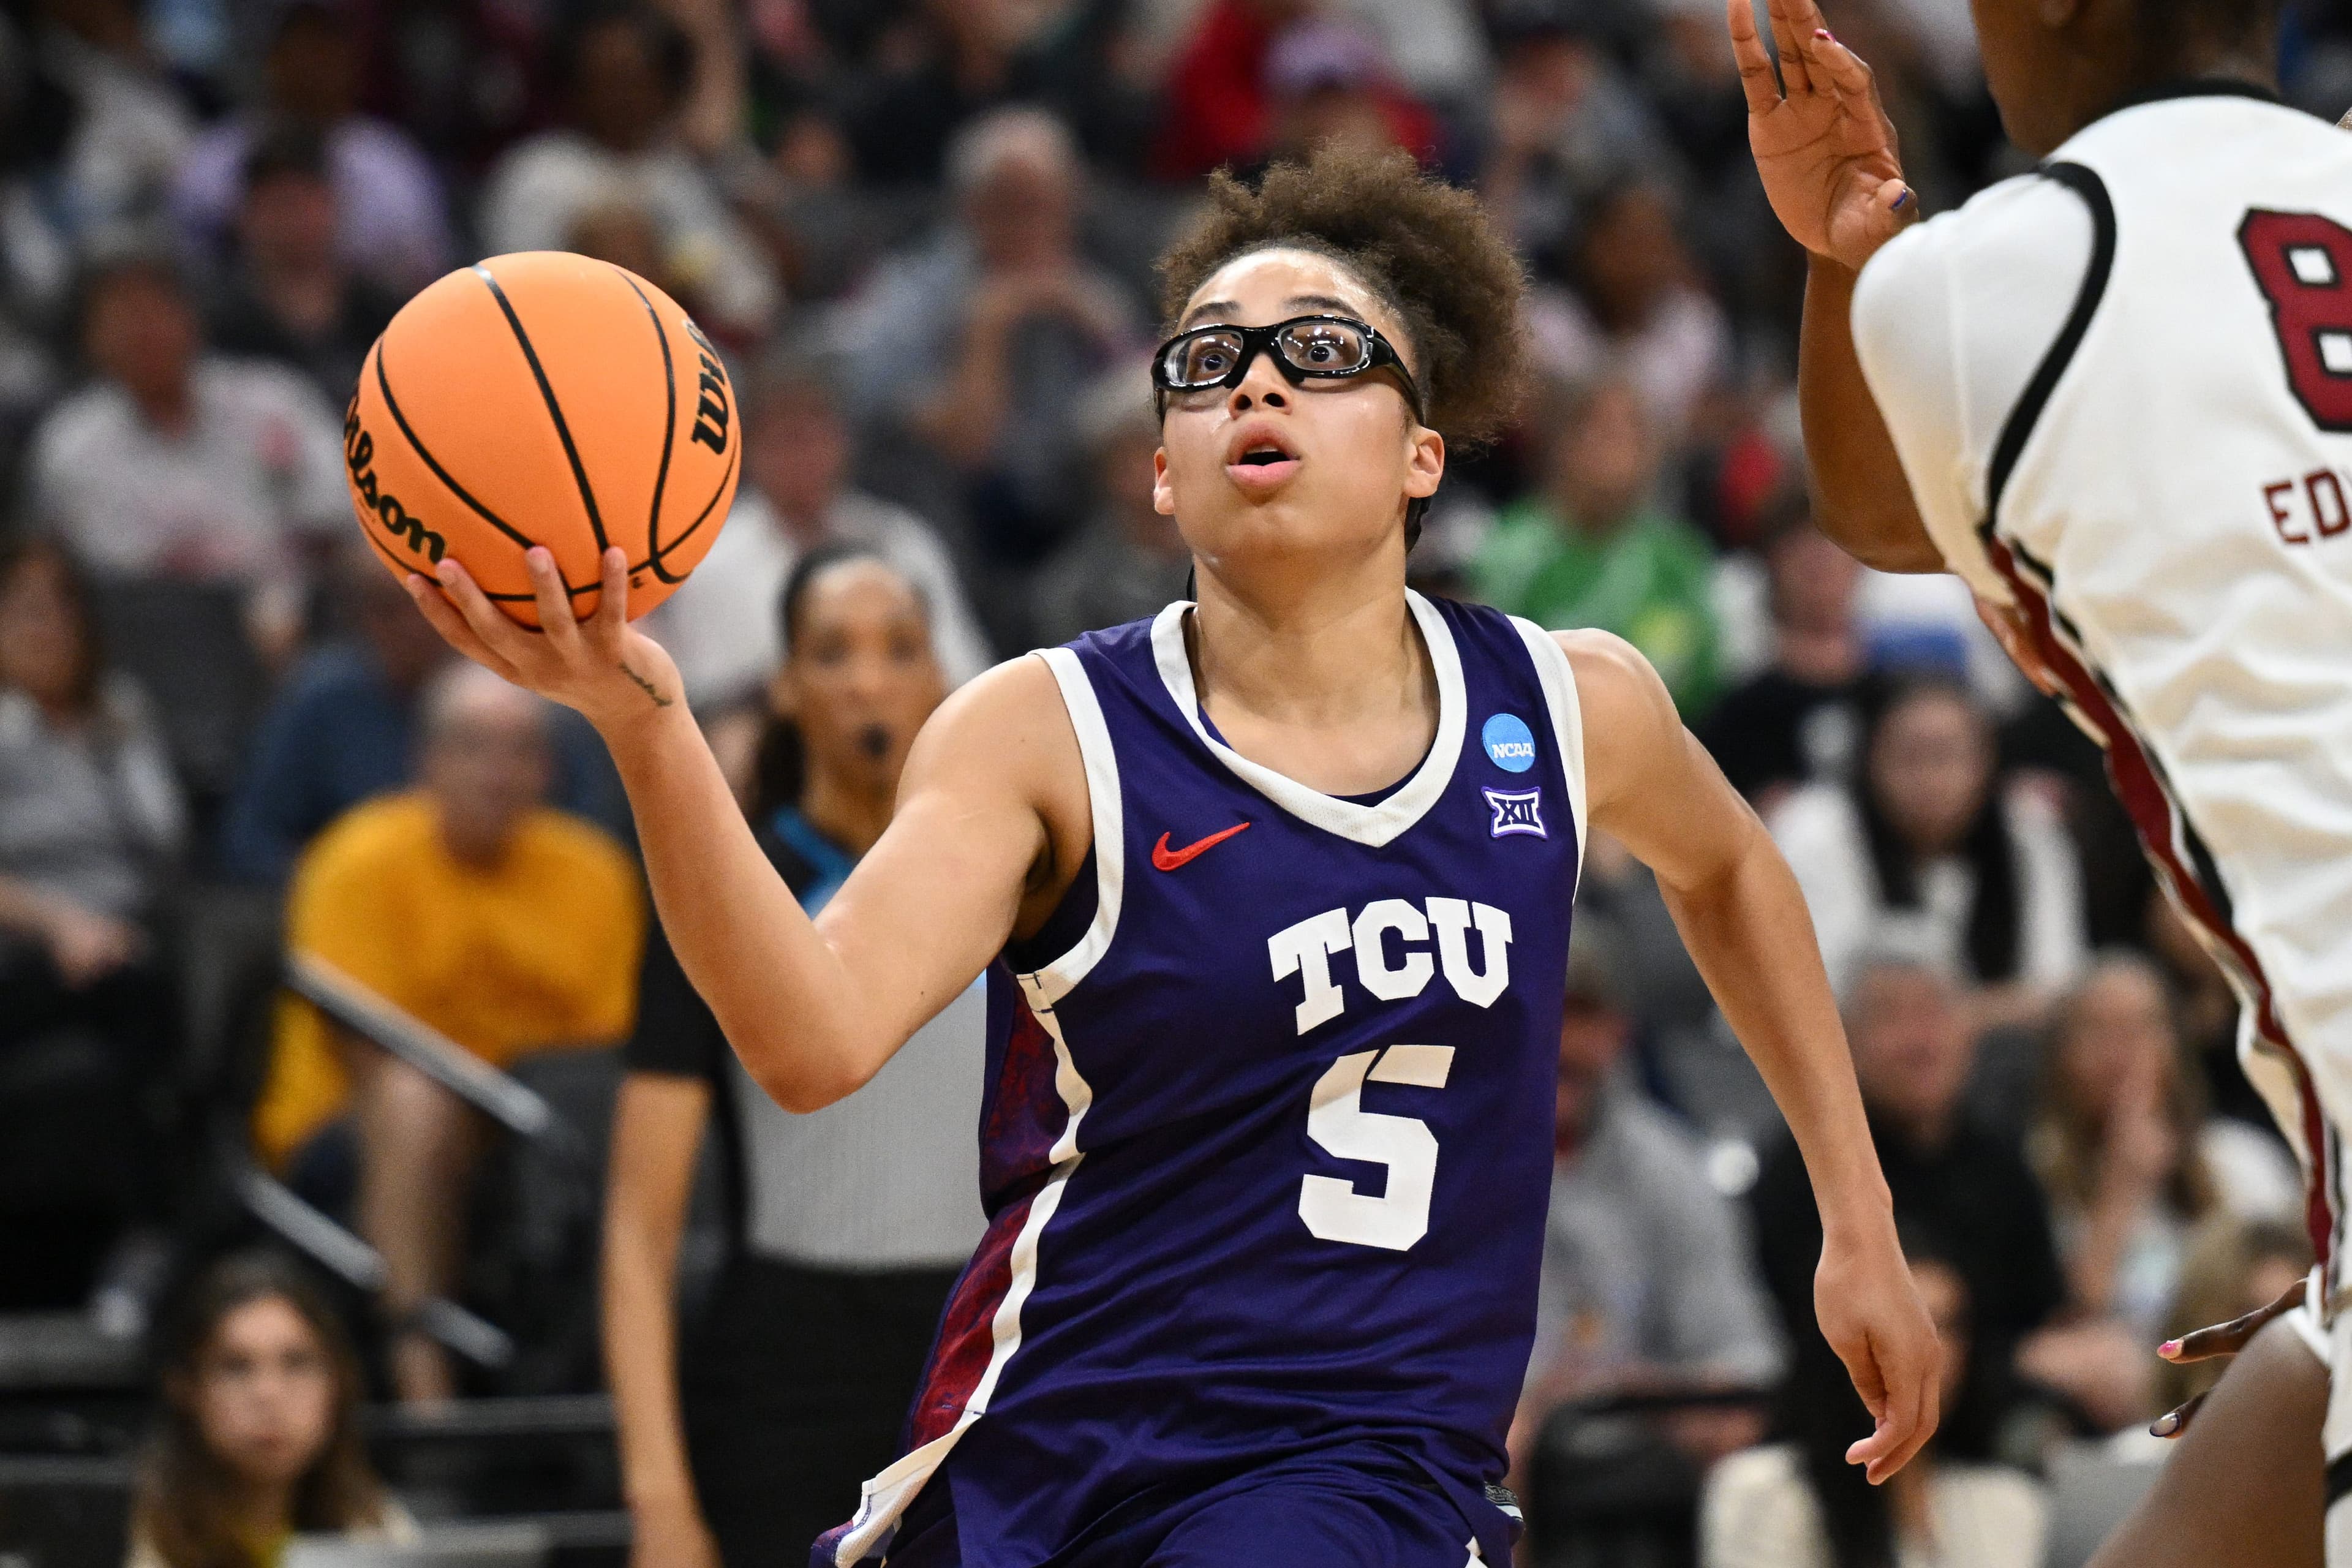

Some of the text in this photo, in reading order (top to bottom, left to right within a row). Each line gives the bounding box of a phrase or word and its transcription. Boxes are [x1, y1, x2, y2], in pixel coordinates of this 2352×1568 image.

[2234, 206, 2352, 432] 8
[2262, 470, 2351, 543] ED
[1491, 742, 1535, 759] NCAA
[1492, 797, 1540, 828] XII
[1268, 897, 1512, 1036] TCU
[1298, 1045, 1455, 1251] 5
